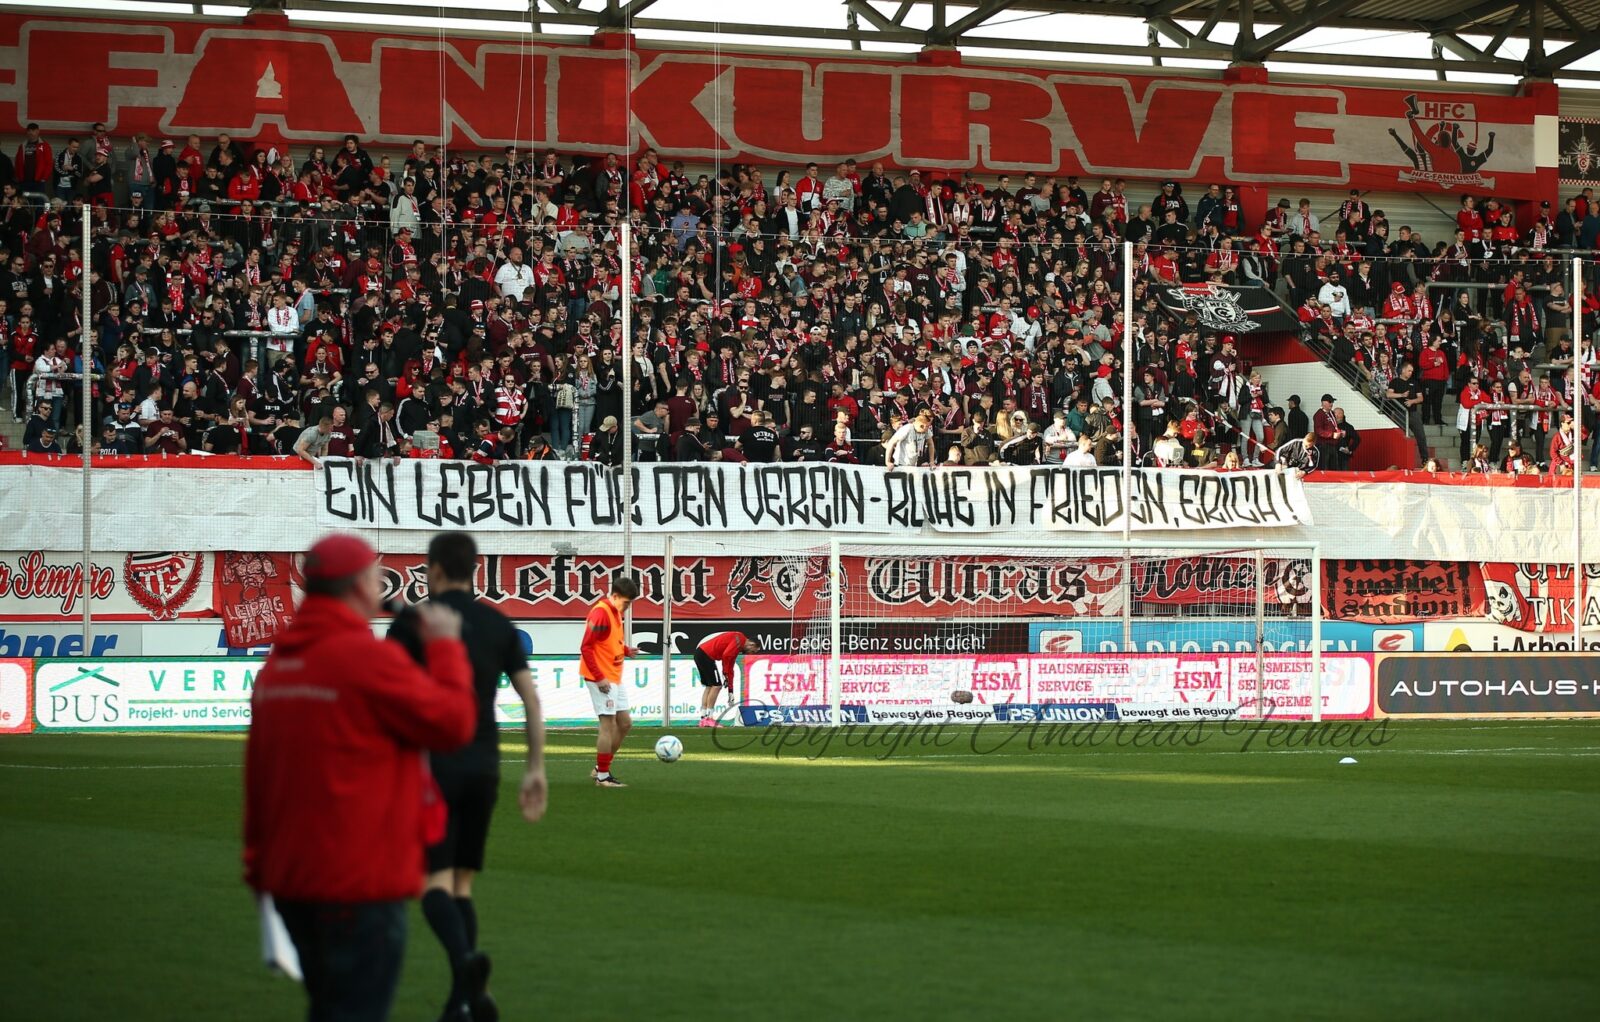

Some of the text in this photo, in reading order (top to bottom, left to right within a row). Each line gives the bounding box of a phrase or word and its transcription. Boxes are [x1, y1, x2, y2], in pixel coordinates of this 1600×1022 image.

[17, 21, 1350, 184] FANKURVE
[1424, 103, 1465, 119] HFC
[324, 460, 399, 524] EIN
[415, 462, 550, 526] LEBEN
[564, 463, 641, 527] FÜR
[652, 465, 728, 528] DEN
[988, 471, 1015, 526] IN
[1179, 473, 1299, 525] ERICH!
[13, 550, 115, 615] Sempre
[864, 557, 1088, 607] Ultras
[757, 634, 986, 650] Mercede-Benz sucht dich!
[1038, 663, 1129, 674] HAUSMEISTER
[764, 673, 816, 692] HSM
[840, 682, 890, 693] ERVICE
[970, 673, 1021, 690] HSM
[1038, 680, 1092, 692] SERVICE
[1174, 672, 1222, 689] HSM
[49, 694, 119, 722] PUS
[128, 706, 252, 721] Projekt- und Servic
[755, 709, 784, 722] PS
[872, 707, 992, 722] bewegt die Region
[1009, 708, 1105, 720] PS UNION
[1122, 705, 1237, 719] bewegt die Region
